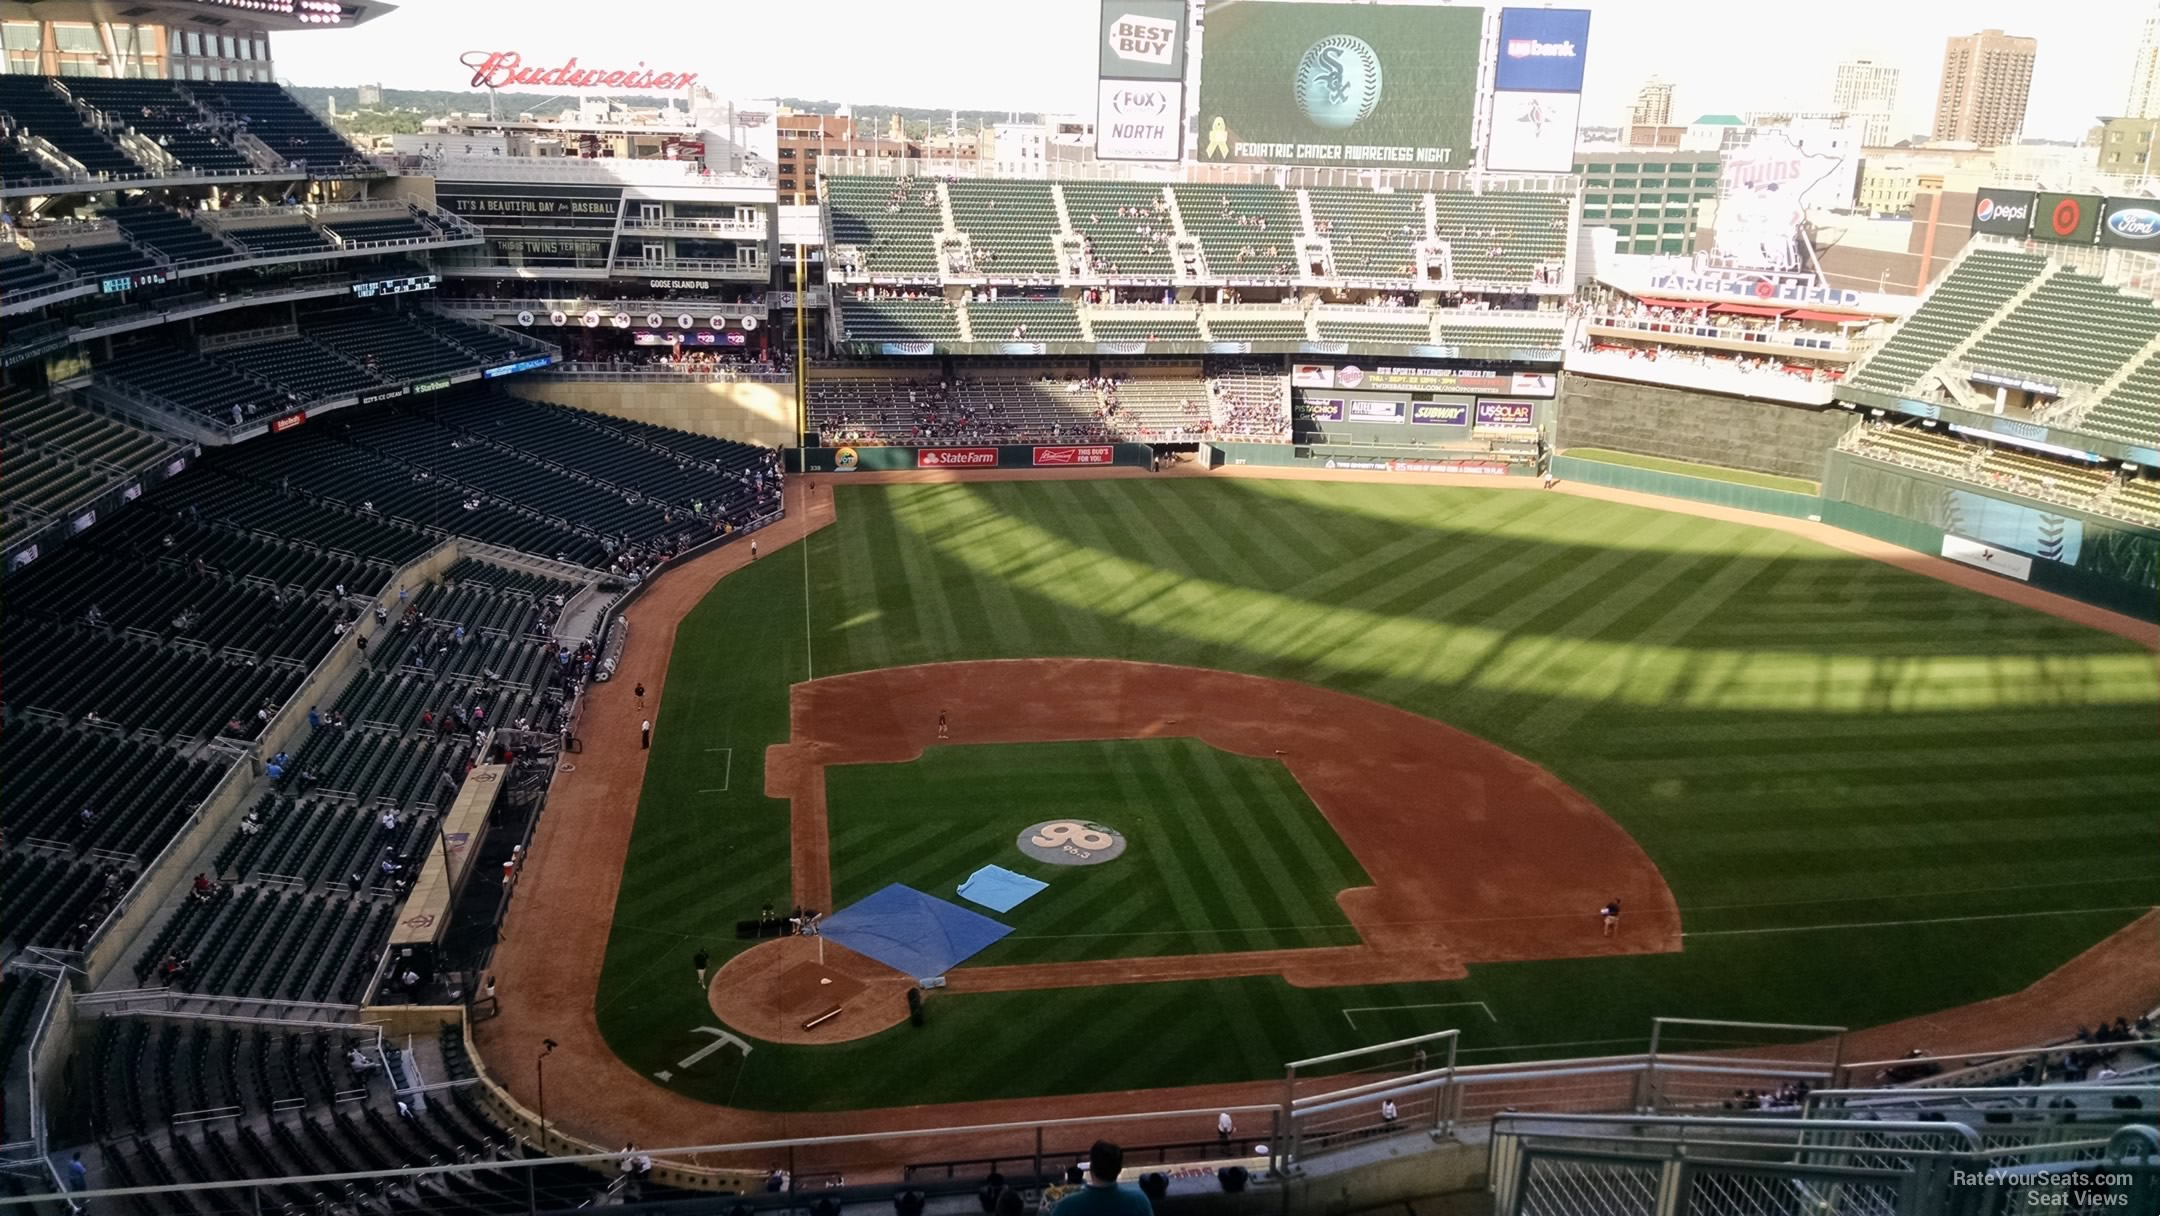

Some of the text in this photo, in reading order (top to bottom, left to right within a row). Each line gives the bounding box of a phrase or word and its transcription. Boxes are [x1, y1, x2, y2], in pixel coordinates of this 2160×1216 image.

[1119, 22, 1173, 42] BEST
[1120, 38, 1167, 56] BUY
[459, 50, 699, 89] Budweiser
[1124, 92, 1155, 107] FOX
[1112, 123, 1164, 139] NORTH
[1234, 142, 1452, 163] PEDIATRIC CANCER AWARENESS NIGHT
[1728, 159, 1801, 191] Twins
[456, 200, 476, 211] IT'S
[479, 201, 486, 211] A
[487, 200, 537, 212] BEAUTIFUL
[539, 201, 554, 212] DAY
[572, 202, 615, 213] BASEBALL
[1993, 204, 2028, 221] pepsi
[2118, 214, 2153, 234] Ford
[497, 241, 600, 253] THIS IS TWINS TERRITORY
[650, 280, 710, 290] GOOSE ISLAND PUB
[1651, 274, 1859, 307] TARGET FIELD
[521, 315, 531, 323] 42
[1337, 370, 1363, 383] Twins
[1414, 406, 1466, 419] SUBWAY
